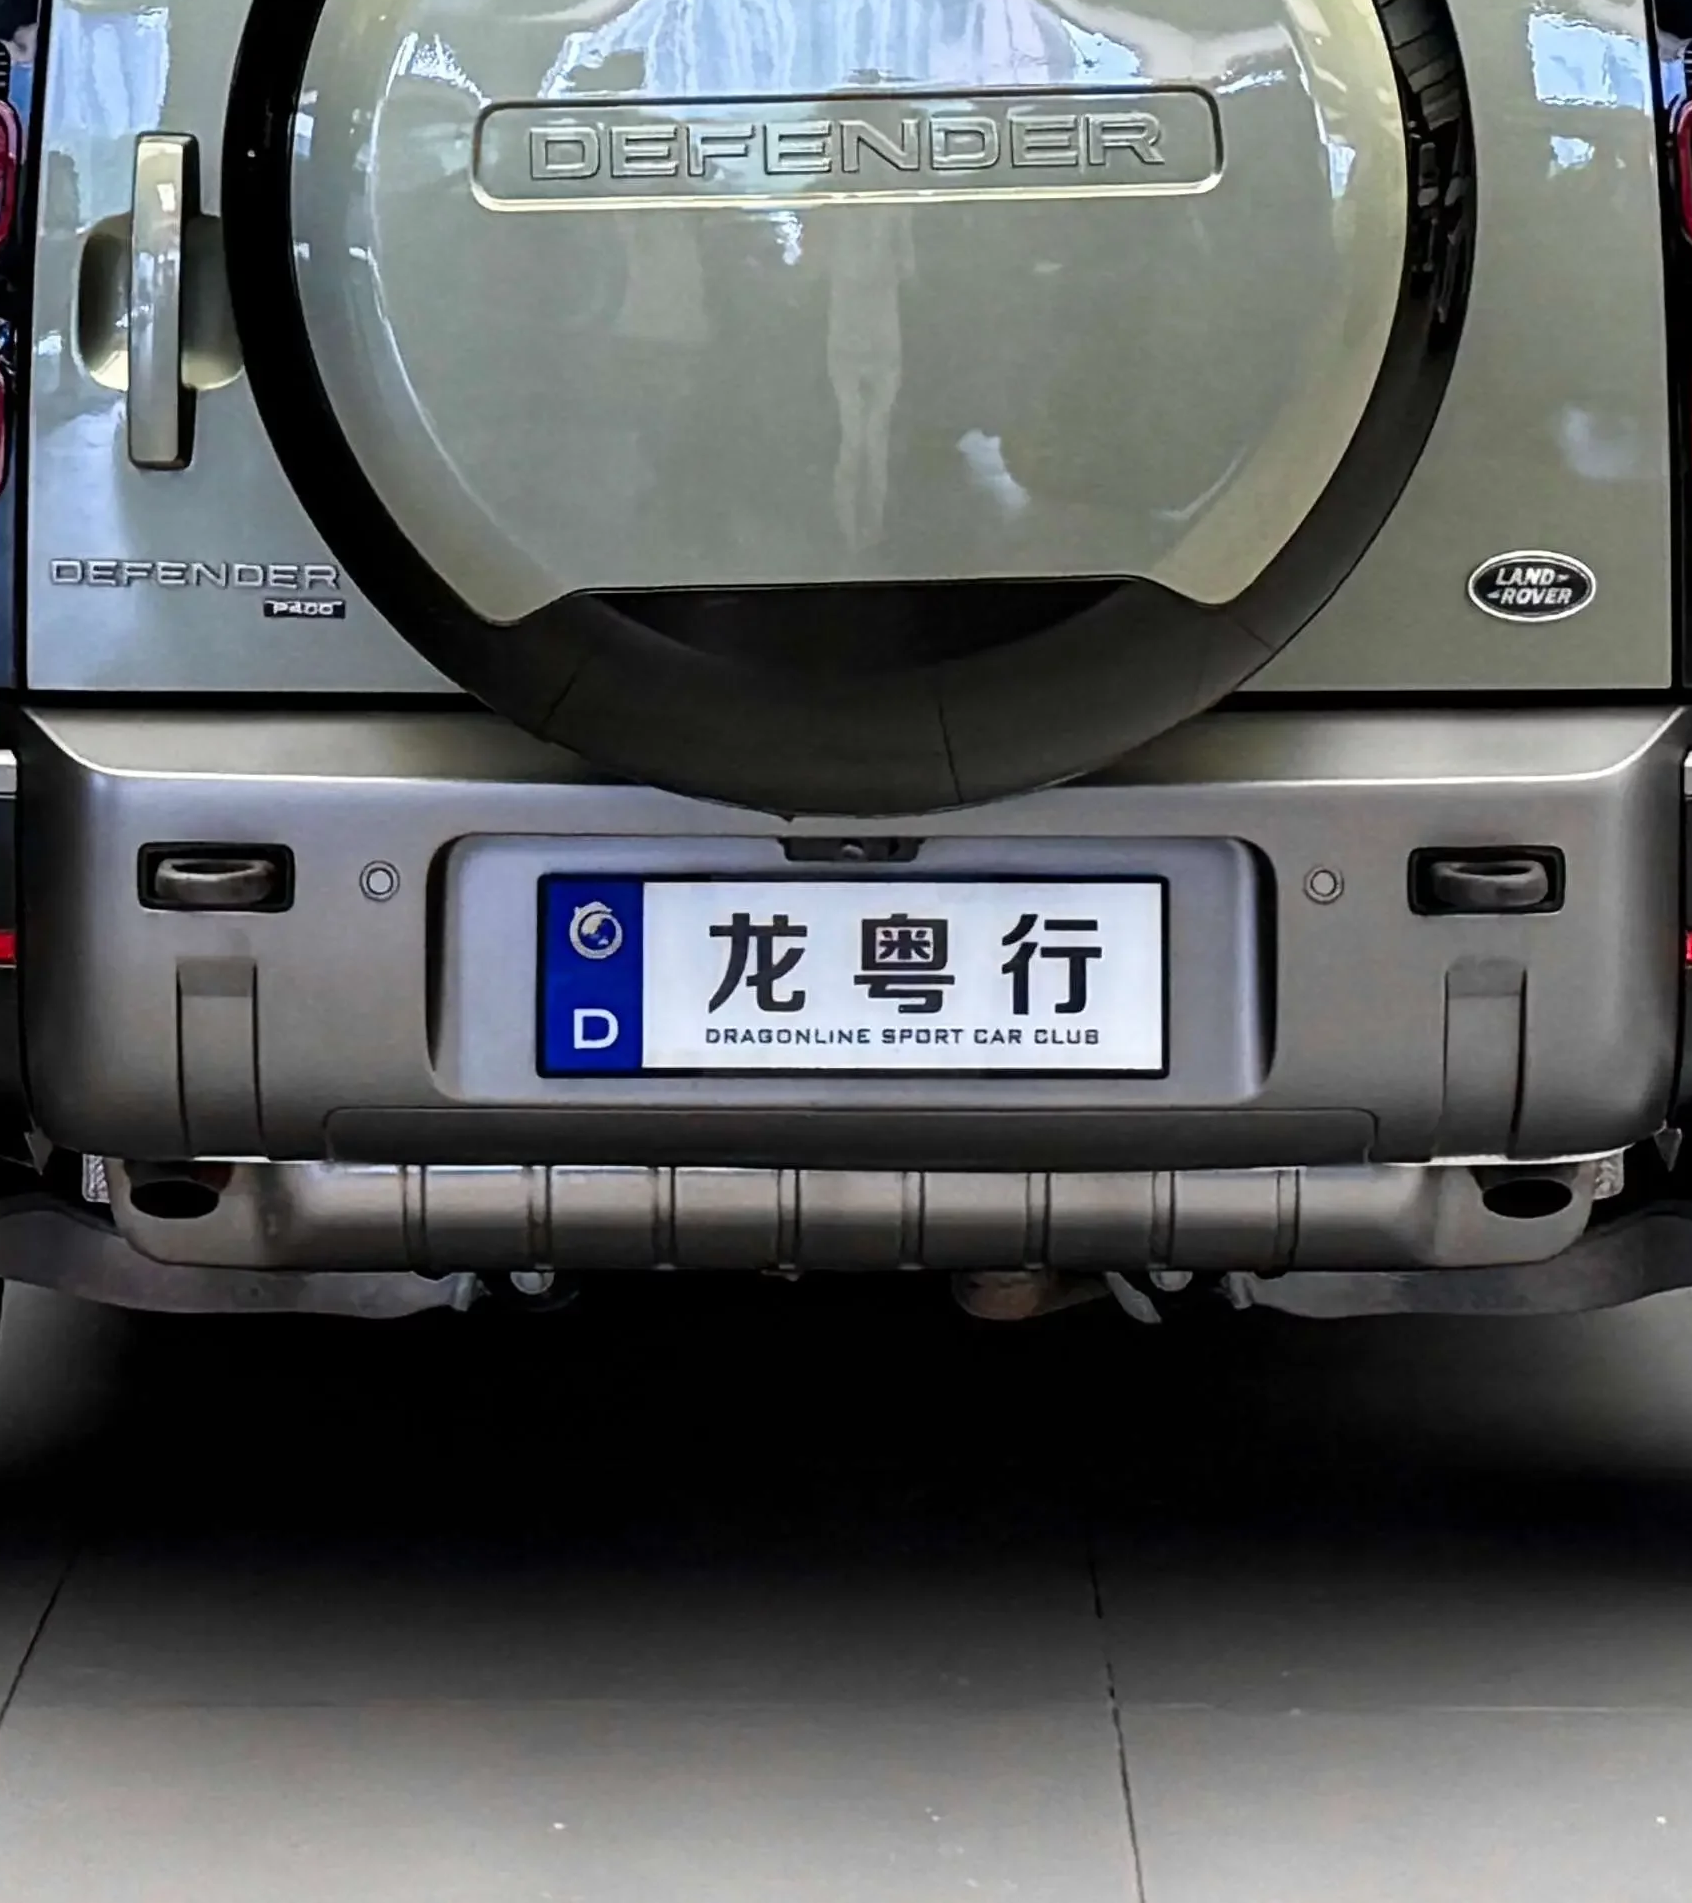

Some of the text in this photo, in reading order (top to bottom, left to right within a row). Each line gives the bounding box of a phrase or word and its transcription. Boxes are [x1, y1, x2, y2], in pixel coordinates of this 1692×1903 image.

[528, 111, 1165, 181] DEFENDER
[50, 559, 340, 591] DEFENDER
[1495, 567, 1556, 585] LAND
[271, 600, 336, 616] P400
[1500, 587, 1573, 605] ROVER
[708, 912, 1103, 1016] 龙粤行
[573, 1007, 620, 1050] D
[705, 1027, 1100, 1046] DRAGONLINE SPORT CAR CLUB
